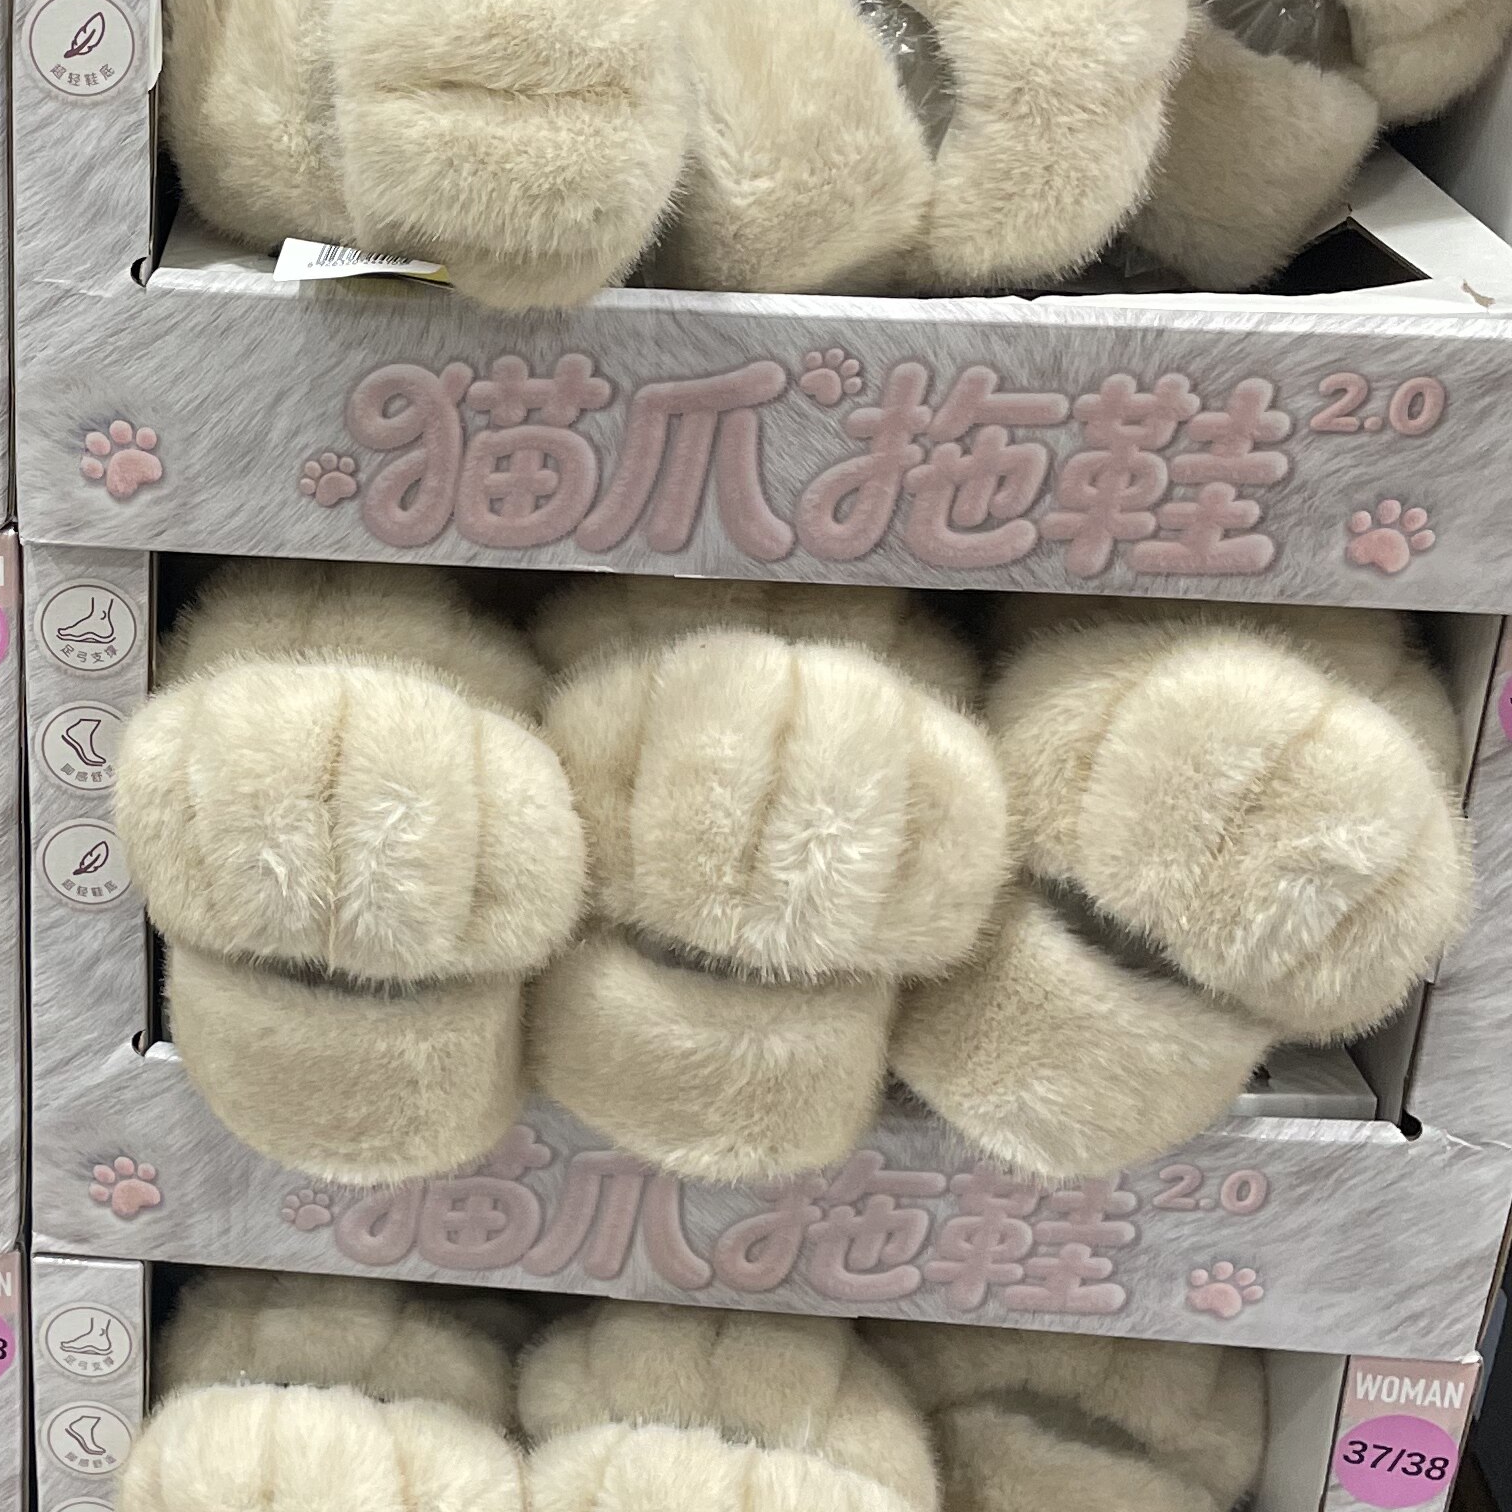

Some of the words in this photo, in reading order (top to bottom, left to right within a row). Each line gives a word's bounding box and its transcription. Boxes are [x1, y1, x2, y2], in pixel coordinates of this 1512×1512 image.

[345, 349, 1291, 578] 猫爪拖鞋
[1308, 370, 1449, 438] 2.0
[1150, 1162, 1273, 1218] 2.0
[1355, 1371, 1465, 1410] WOMAN
[1342, 1439, 1450, 1481] 37/38
